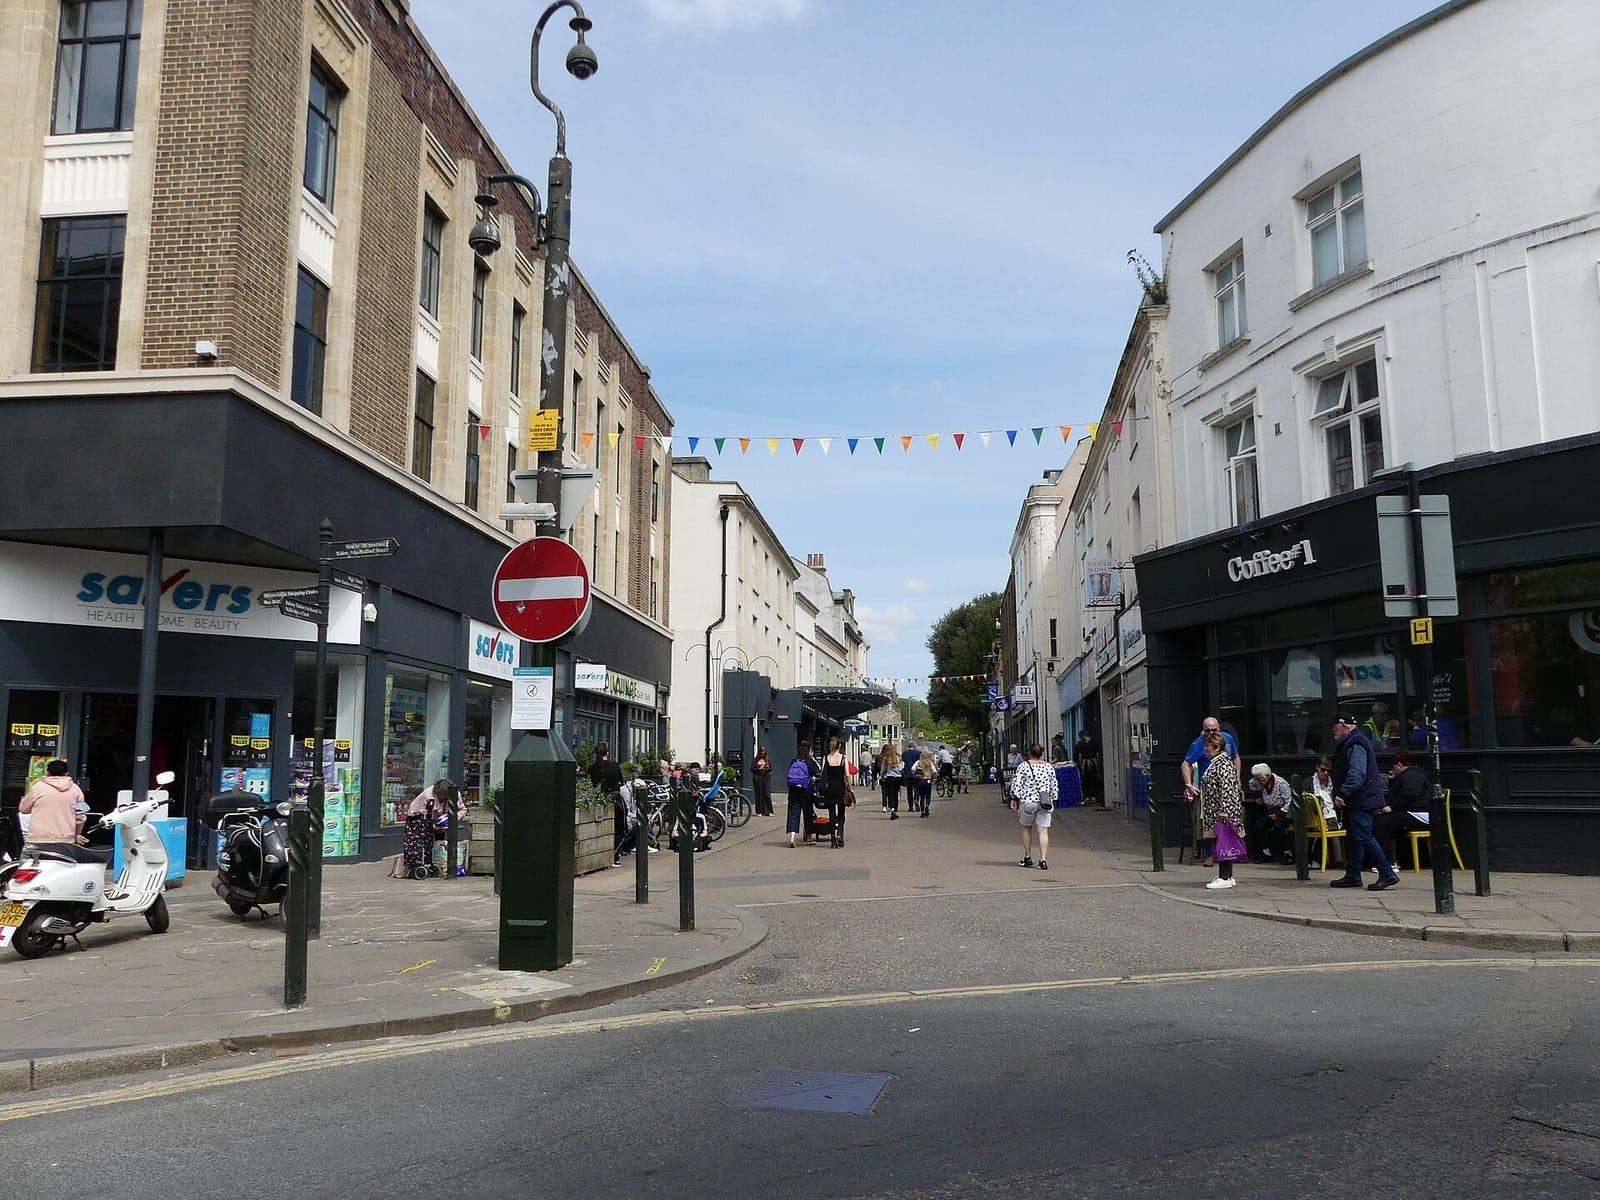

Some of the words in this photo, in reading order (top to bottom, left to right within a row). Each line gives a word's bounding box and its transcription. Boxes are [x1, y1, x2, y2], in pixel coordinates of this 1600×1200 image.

[87, 610, 135, 624] HEALTH
[158, 615, 184, 628] OME
[194, 618, 240, 632] BEAUTY
[1413, 620, 1428, 642] H
[475, 631, 514, 665] savers
[577, 671, 604, 680] savers
